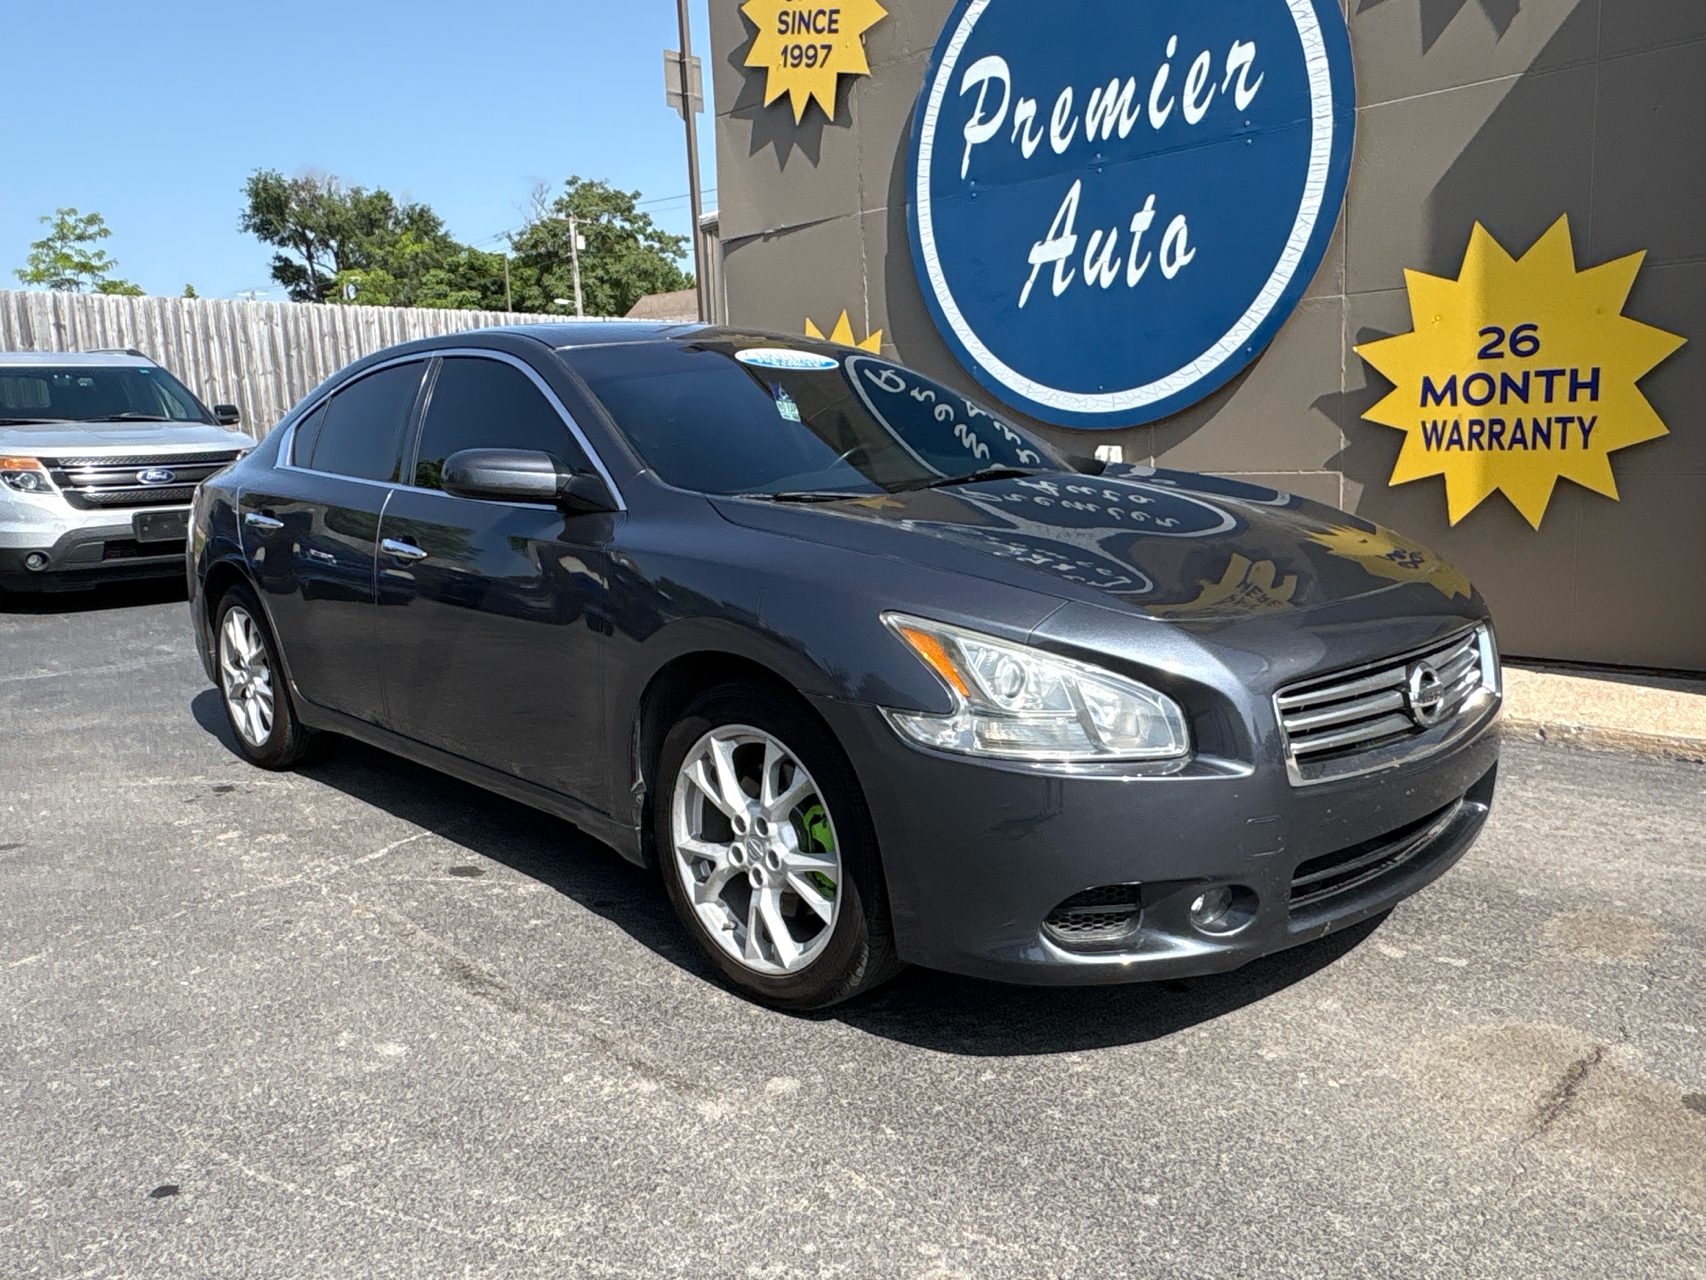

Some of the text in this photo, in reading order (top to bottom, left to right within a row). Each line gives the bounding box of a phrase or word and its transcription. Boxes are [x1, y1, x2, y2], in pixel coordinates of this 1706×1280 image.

[777, 9, 840, 35] SINCE
[781, 44, 832, 68] 1997
[959, 35, 1264, 179] Premier
[1019, 180, 1196, 309] Auto
[1477, 323, 1541, 360] 26
[1420, 367, 1600, 408] MONTH
[1421, 415, 1598, 452] WARRANTY
